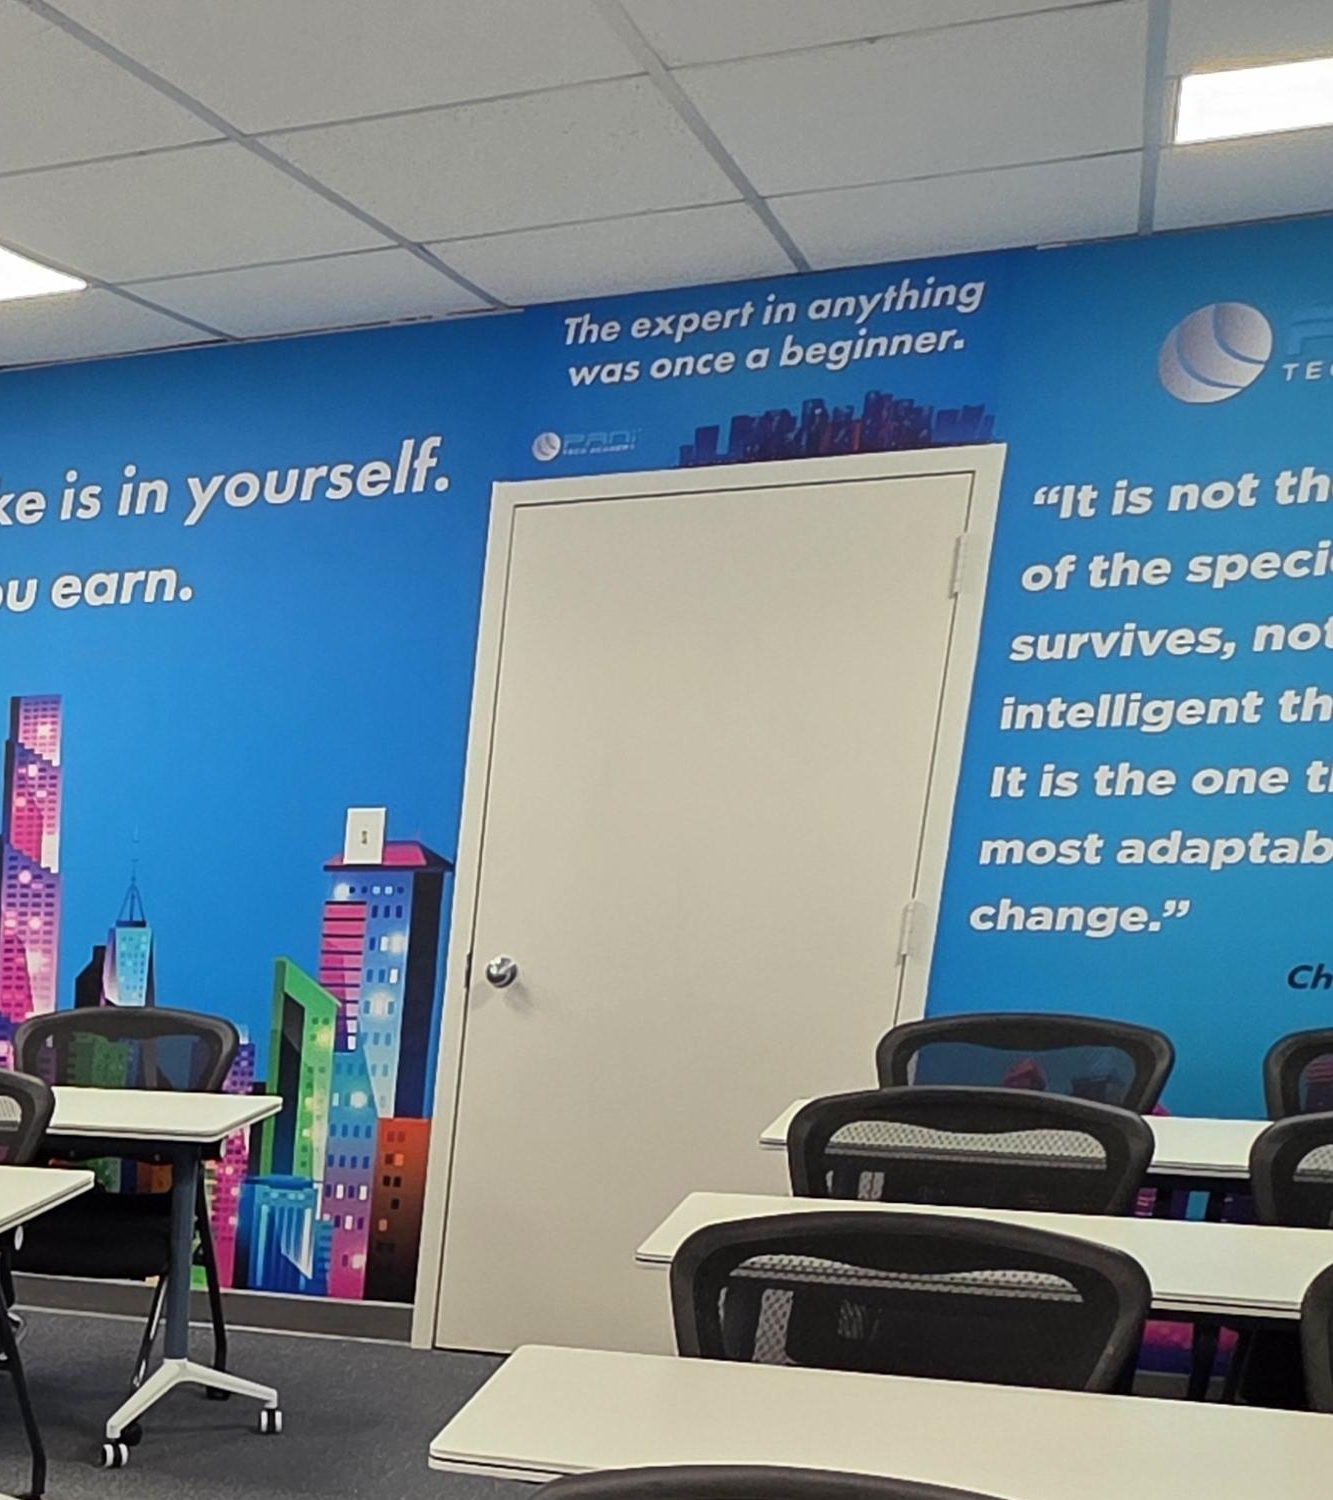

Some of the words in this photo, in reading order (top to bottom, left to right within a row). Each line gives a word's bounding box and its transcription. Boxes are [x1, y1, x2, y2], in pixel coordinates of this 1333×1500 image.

[564, 314, 622, 346] The
[631, 303, 755, 343] expert
[763, 294, 796, 325] in
[808, 276, 986, 313] anything
[569, 362, 641, 386] was
[650, 352, 736, 379] once
[746, 349, 769, 369] a
[779, 328, 965, 371] beginner.
[1282, 360, 1333, 382] TE
[60, 470, 102, 521] is
[117, 465, 169, 516] in
[183, 437, 449, 526] yourself.
[1111, 479, 1153, 516] is
[1167, 473, 1259, 511] not
[1275, 467, 1333, 504] th
[51, 567, 193, 609] earn.
[1022, 555, 1077, 592] of
[1088, 552, 1171, 588] the
[1009, 622, 1236, 661] survives,
[999, 691, 1263, 733] intelligent
[990, 765, 1026, 798] It
[1039, 764, 1080, 797] is
[1094, 762, 1176, 797] the
[1191, 766, 1290, 796] one
[1306, 759, 1333, 794] t
[979, 832, 1104, 867] most
